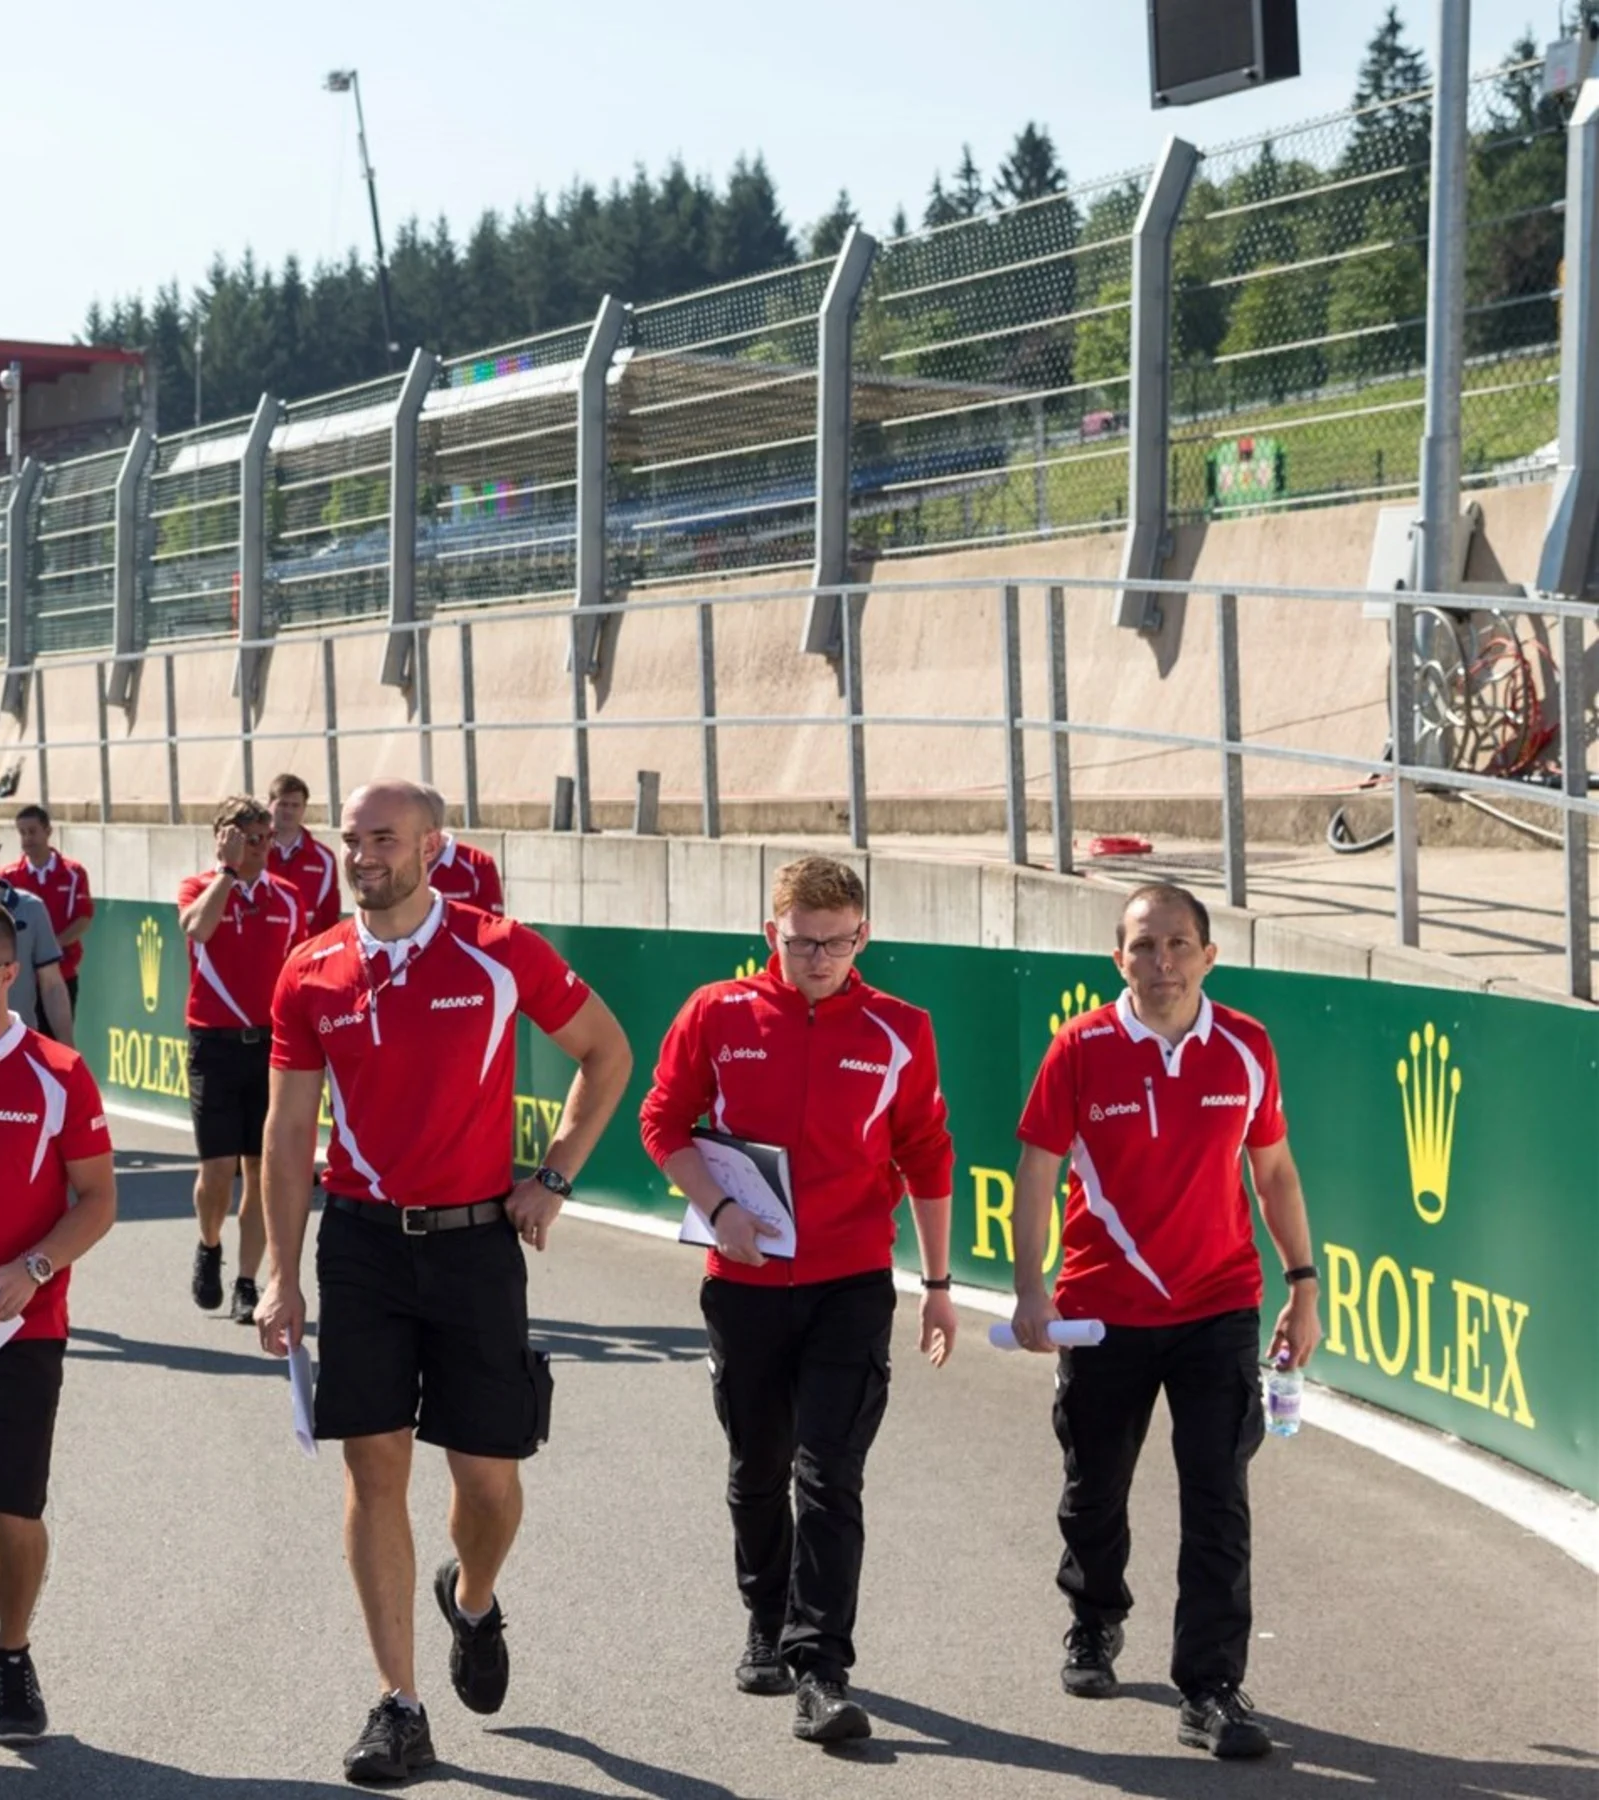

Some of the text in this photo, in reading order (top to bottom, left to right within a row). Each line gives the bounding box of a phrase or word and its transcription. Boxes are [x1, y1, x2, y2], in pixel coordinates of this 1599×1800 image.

[334, 1011, 365, 1028] airbnb
[733, 1047, 767, 1060] airbnb
[108, 1026, 190, 1099] ROLEX
[1104, 1101, 1142, 1117] airbnb
[1323, 1242, 1536, 1429] ROLEX
